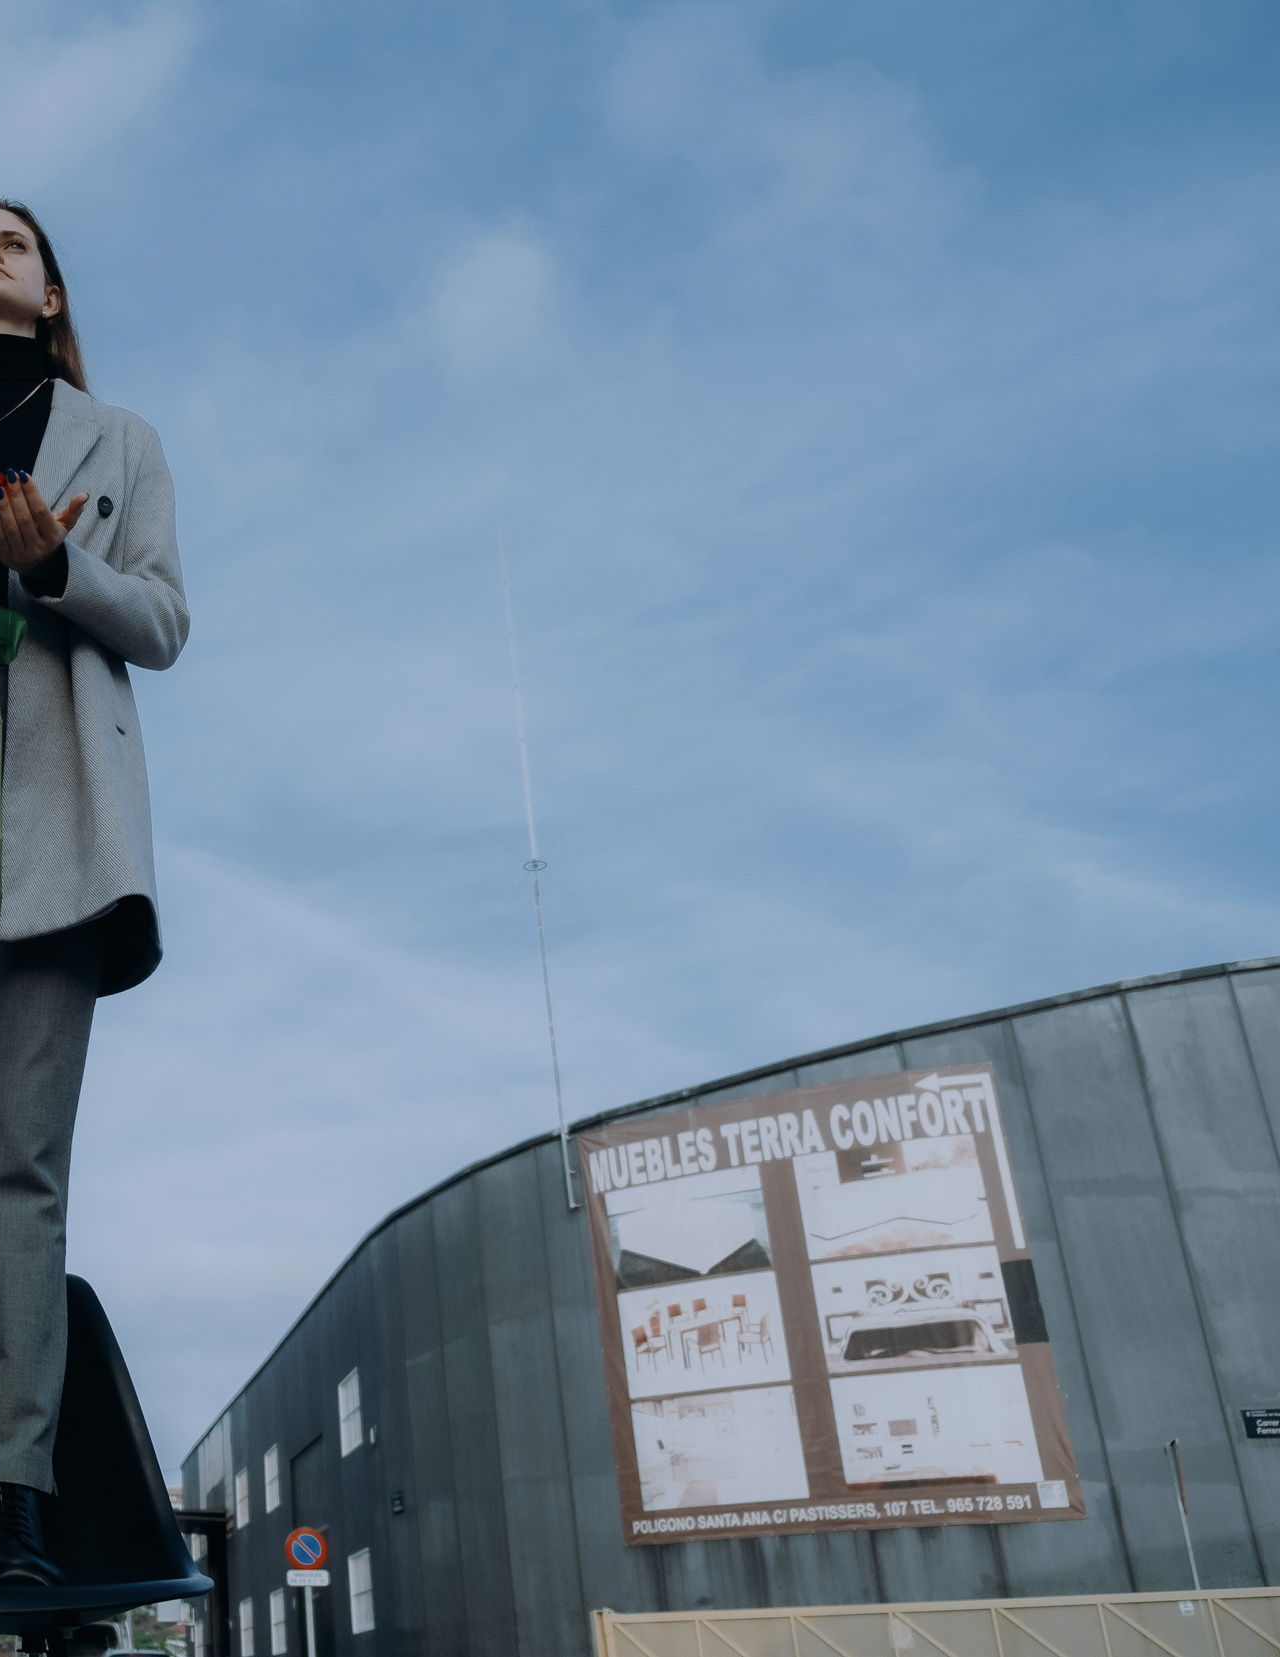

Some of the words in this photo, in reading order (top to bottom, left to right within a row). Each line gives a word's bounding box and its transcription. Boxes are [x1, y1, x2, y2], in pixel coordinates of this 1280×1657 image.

[588, 1128, 717, 1195] MUEBLES
[720, 1109, 826, 1168] TERRA
[829, 1086, 988, 1152] CONFORT
[632, 1516, 696, 1535] POLIGONO
[697, 1512, 743, 1530] SANTA
[742, 1510, 771, 1526] ANA
[772, 1508, 788, 1524] C/
[789, 1502, 881, 1523] PASTISSERS,
[883, 1501, 908, 1517] 107
[912, 1499, 945, 1516] TEL.
[947, 1496, 973, 1513] 965
[976, 1495, 1003, 1512] 728
[1005, 1494, 1032, 1510] 591
